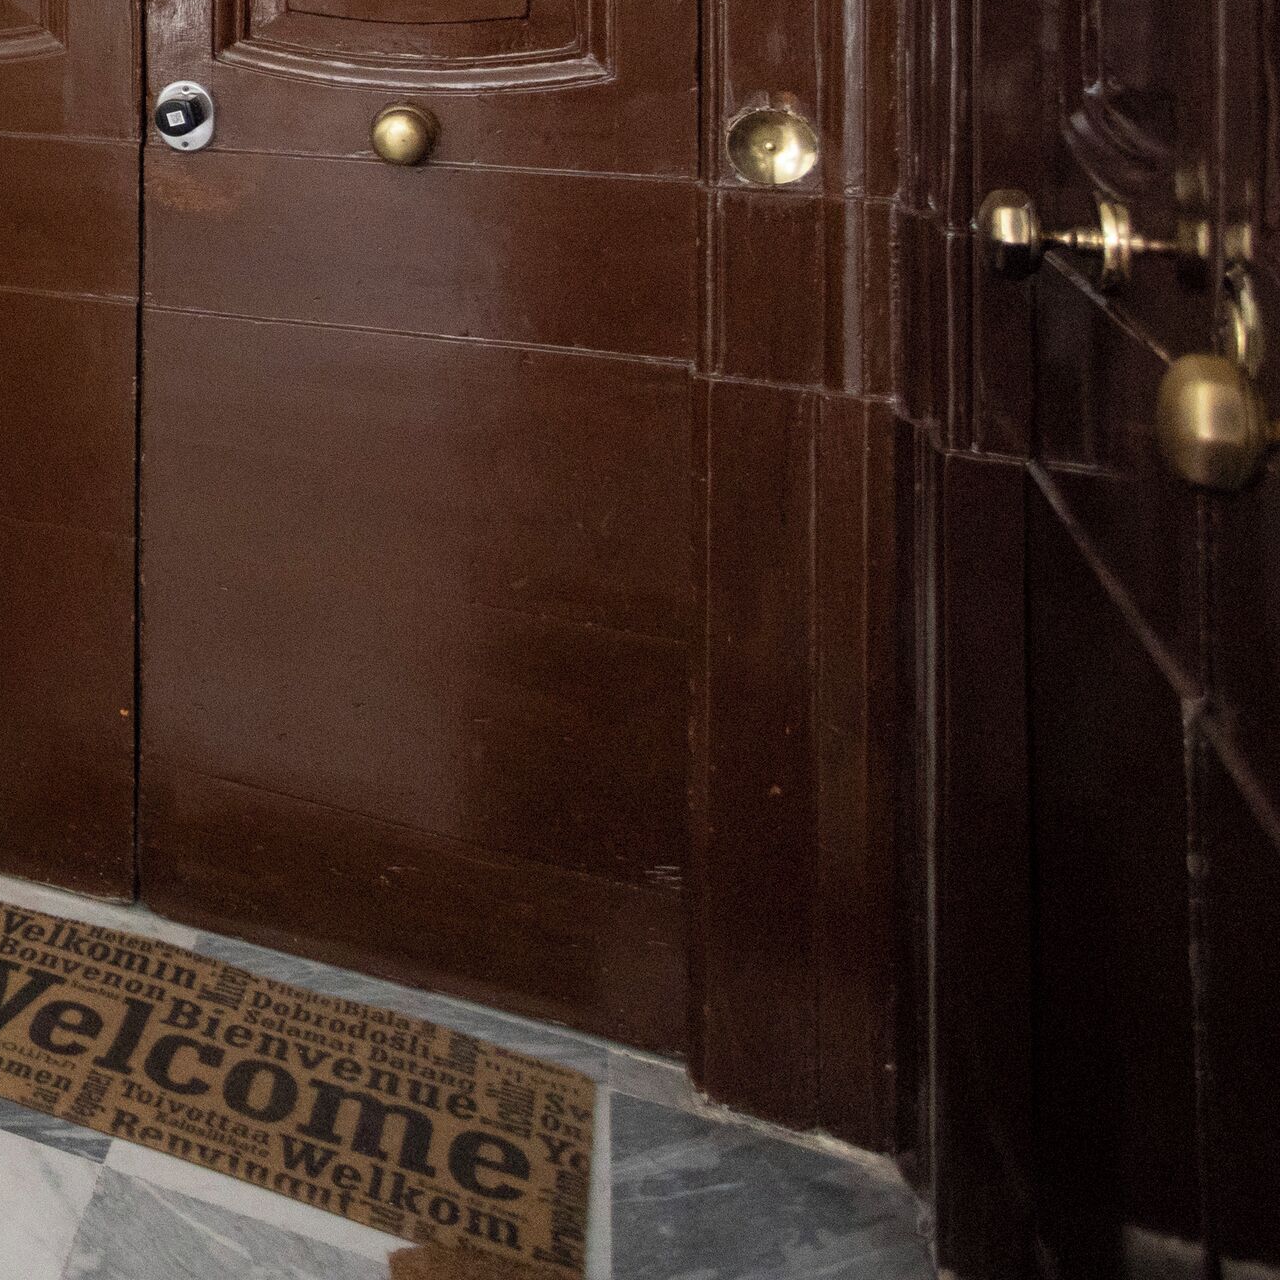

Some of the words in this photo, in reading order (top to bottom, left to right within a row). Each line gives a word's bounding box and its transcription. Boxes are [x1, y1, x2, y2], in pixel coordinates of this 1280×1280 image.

[3, 909, 197, 989] Velkomin
[166, 996, 477, 1120] Bienvenue
[280, 1134, 521, 1251] Welkom
